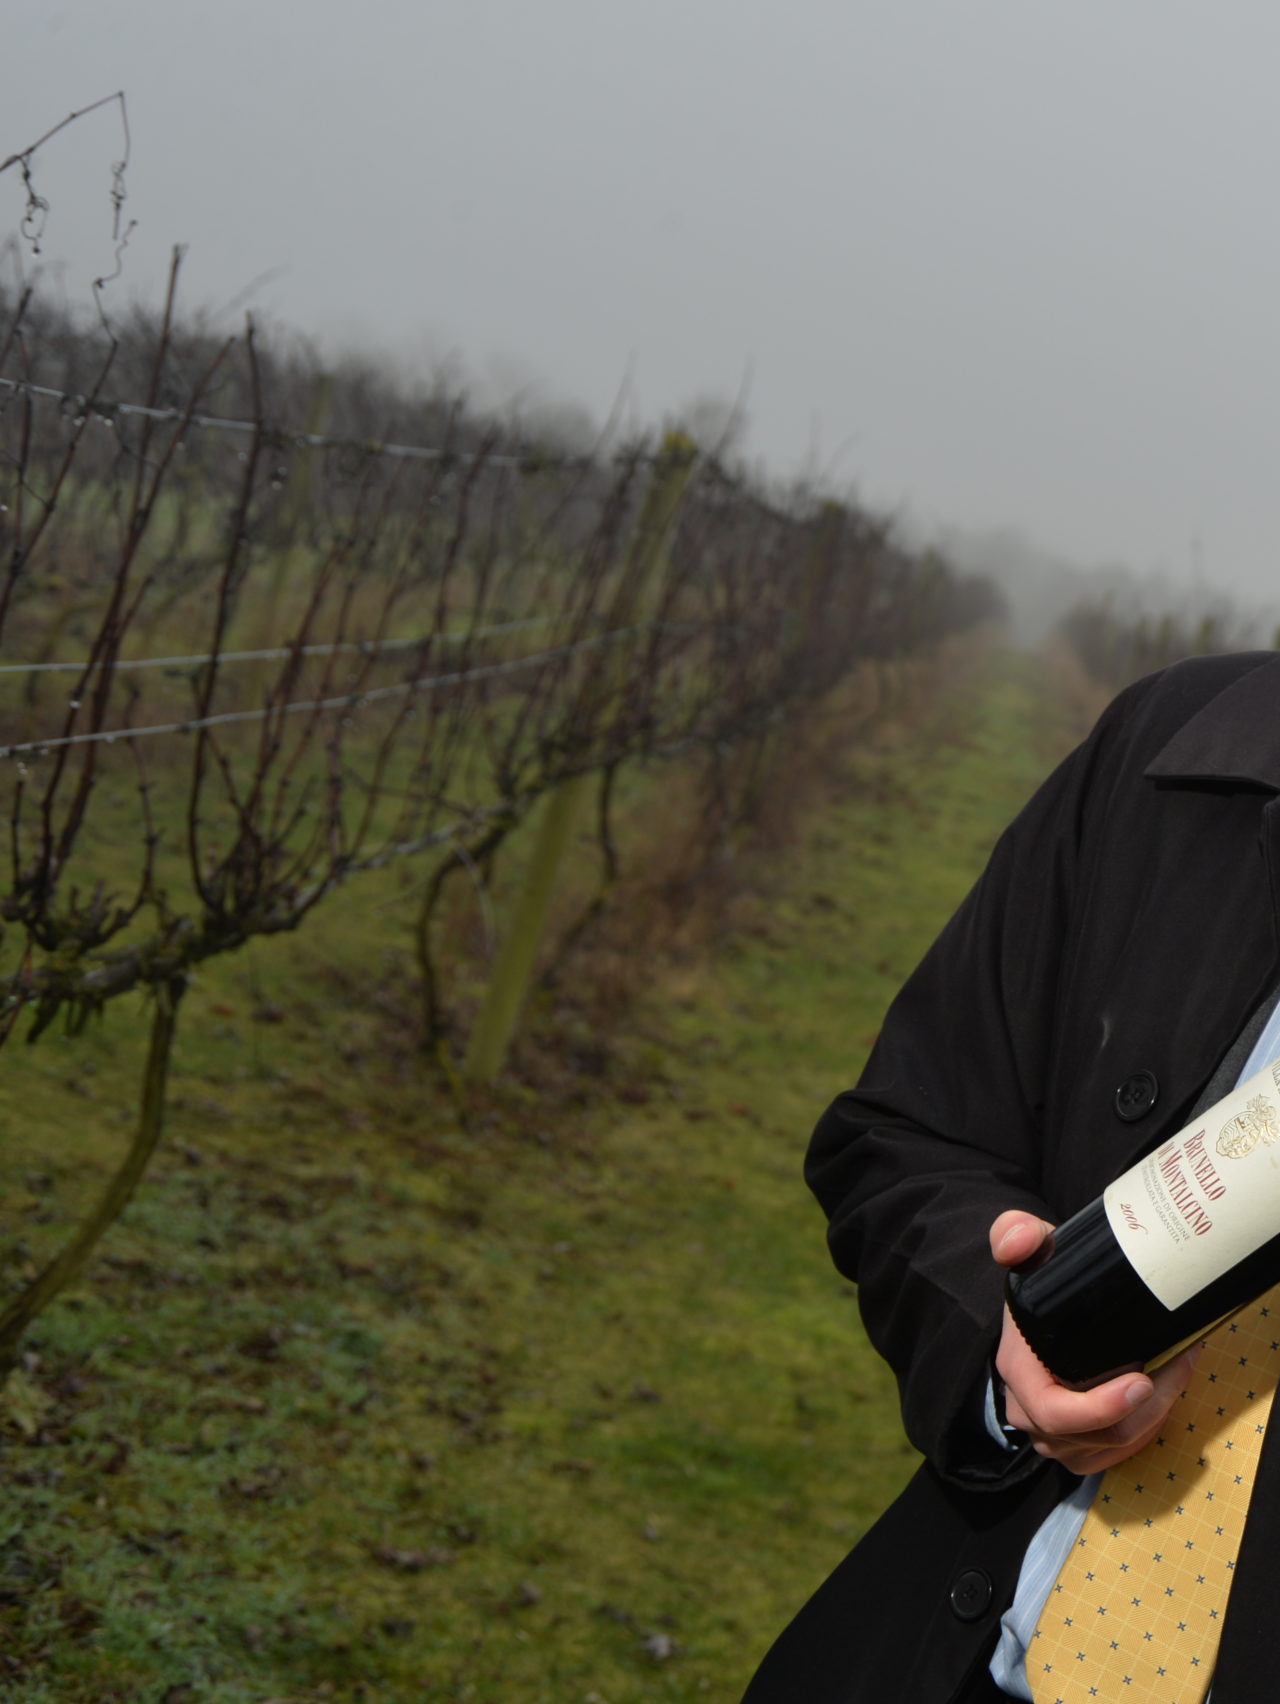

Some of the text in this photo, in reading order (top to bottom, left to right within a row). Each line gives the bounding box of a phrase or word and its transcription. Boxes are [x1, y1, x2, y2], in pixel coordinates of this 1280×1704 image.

[1159, 1149, 1213, 1236] MONTALCINO
[1183, 1129, 1226, 1201] BRUNELLO
[1119, 1203, 1149, 1236] 2006
